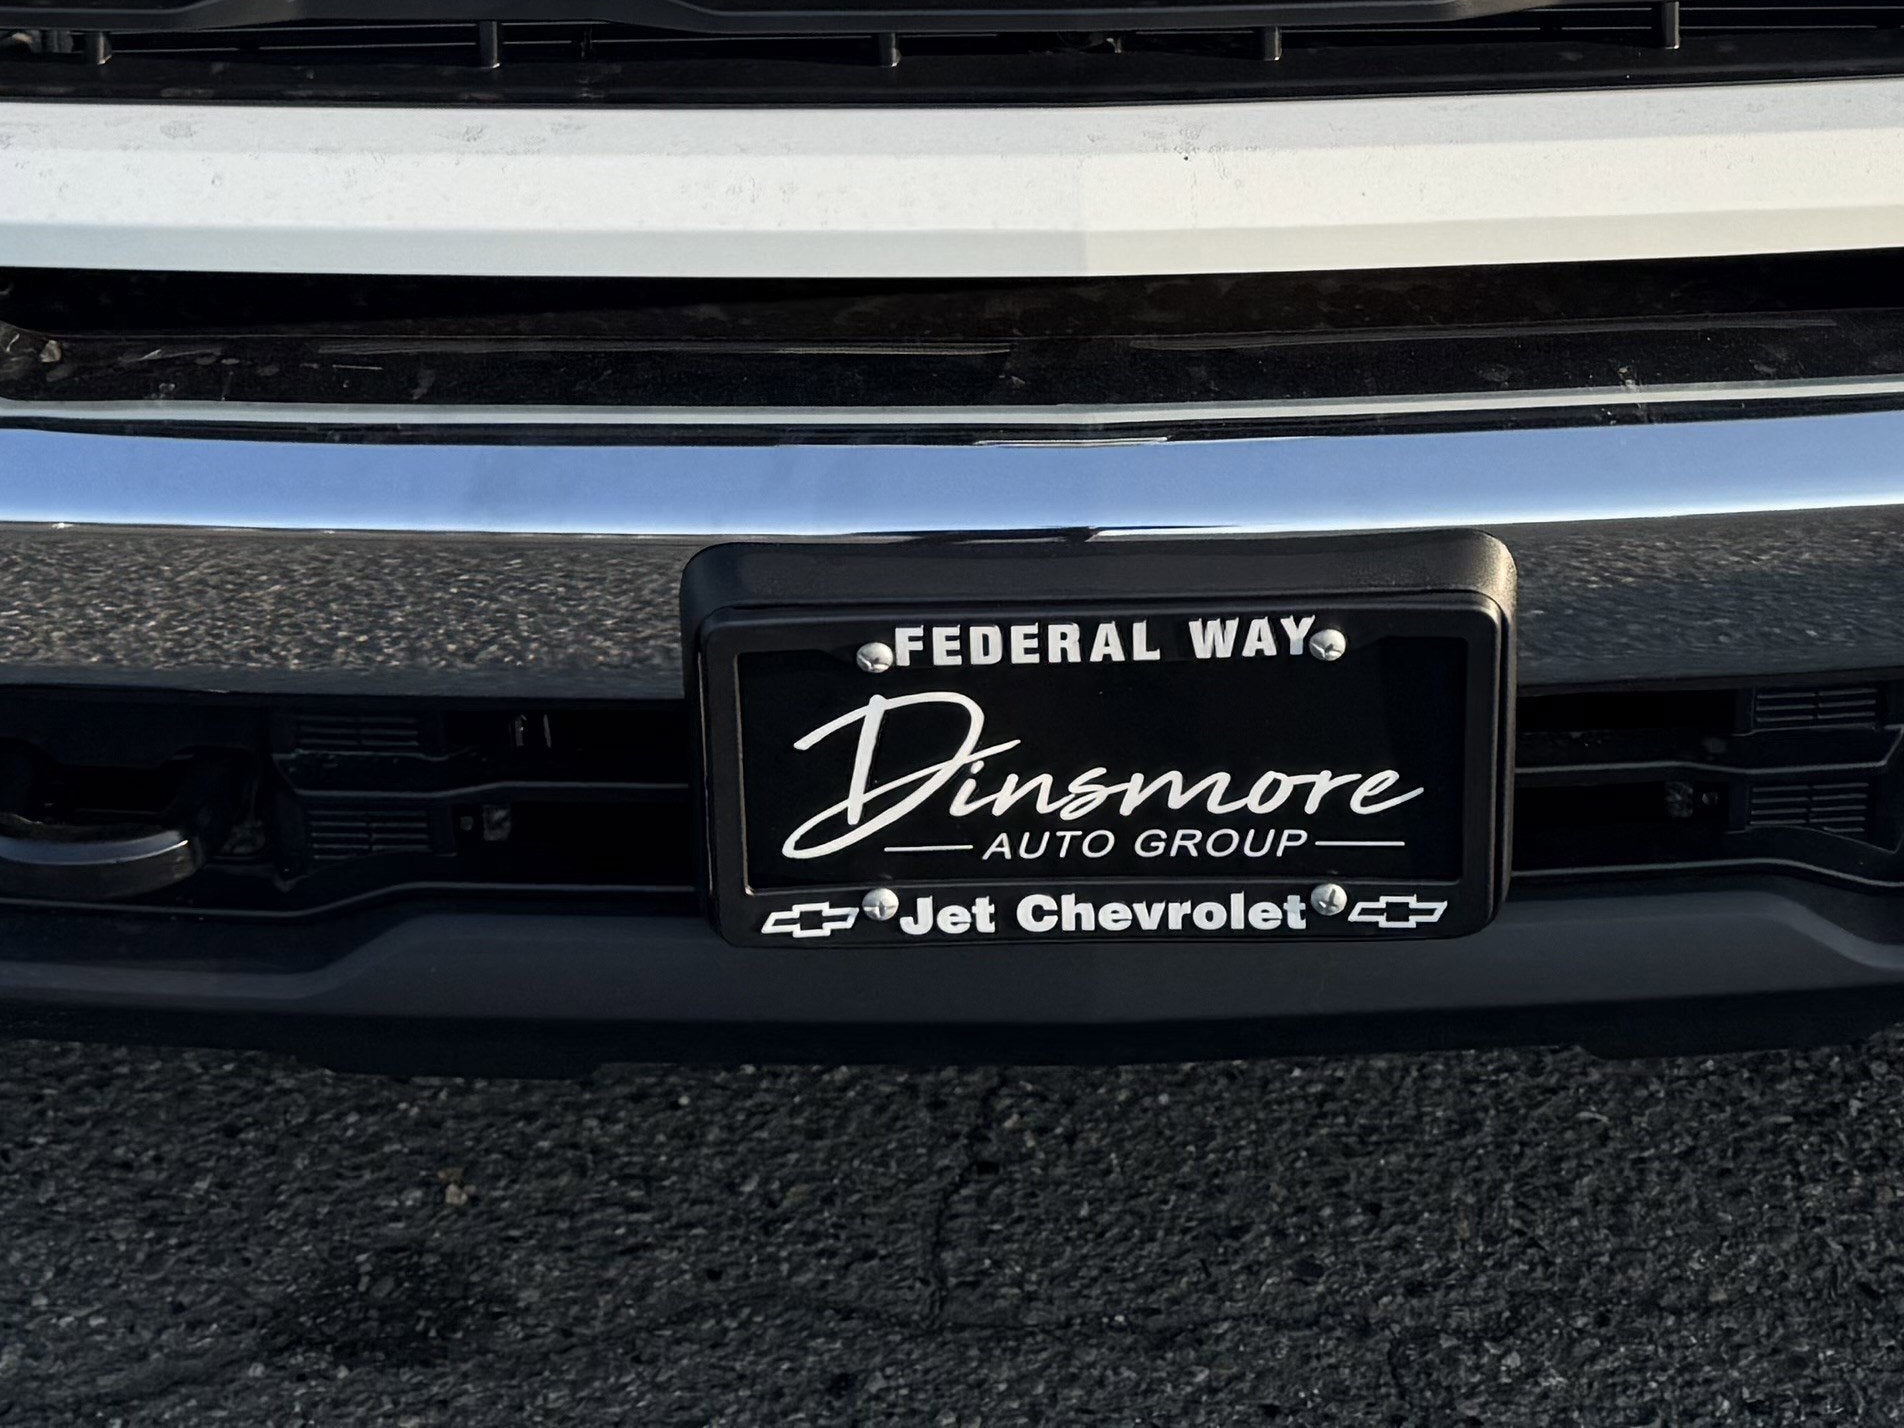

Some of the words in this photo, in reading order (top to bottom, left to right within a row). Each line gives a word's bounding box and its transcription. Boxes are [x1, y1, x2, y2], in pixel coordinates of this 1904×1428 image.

[893, 620, 1161, 667] FEDERAL
[1189, 614, 1316, 659] WAY
[781, 691, 1424, 860] Dinsmore
[982, 828, 1115, 860] AUTO
[1133, 828, 1309, 858] GROUP
[898, 894, 996, 936] Jet
[1016, 891, 1307, 933] Chevrolet
